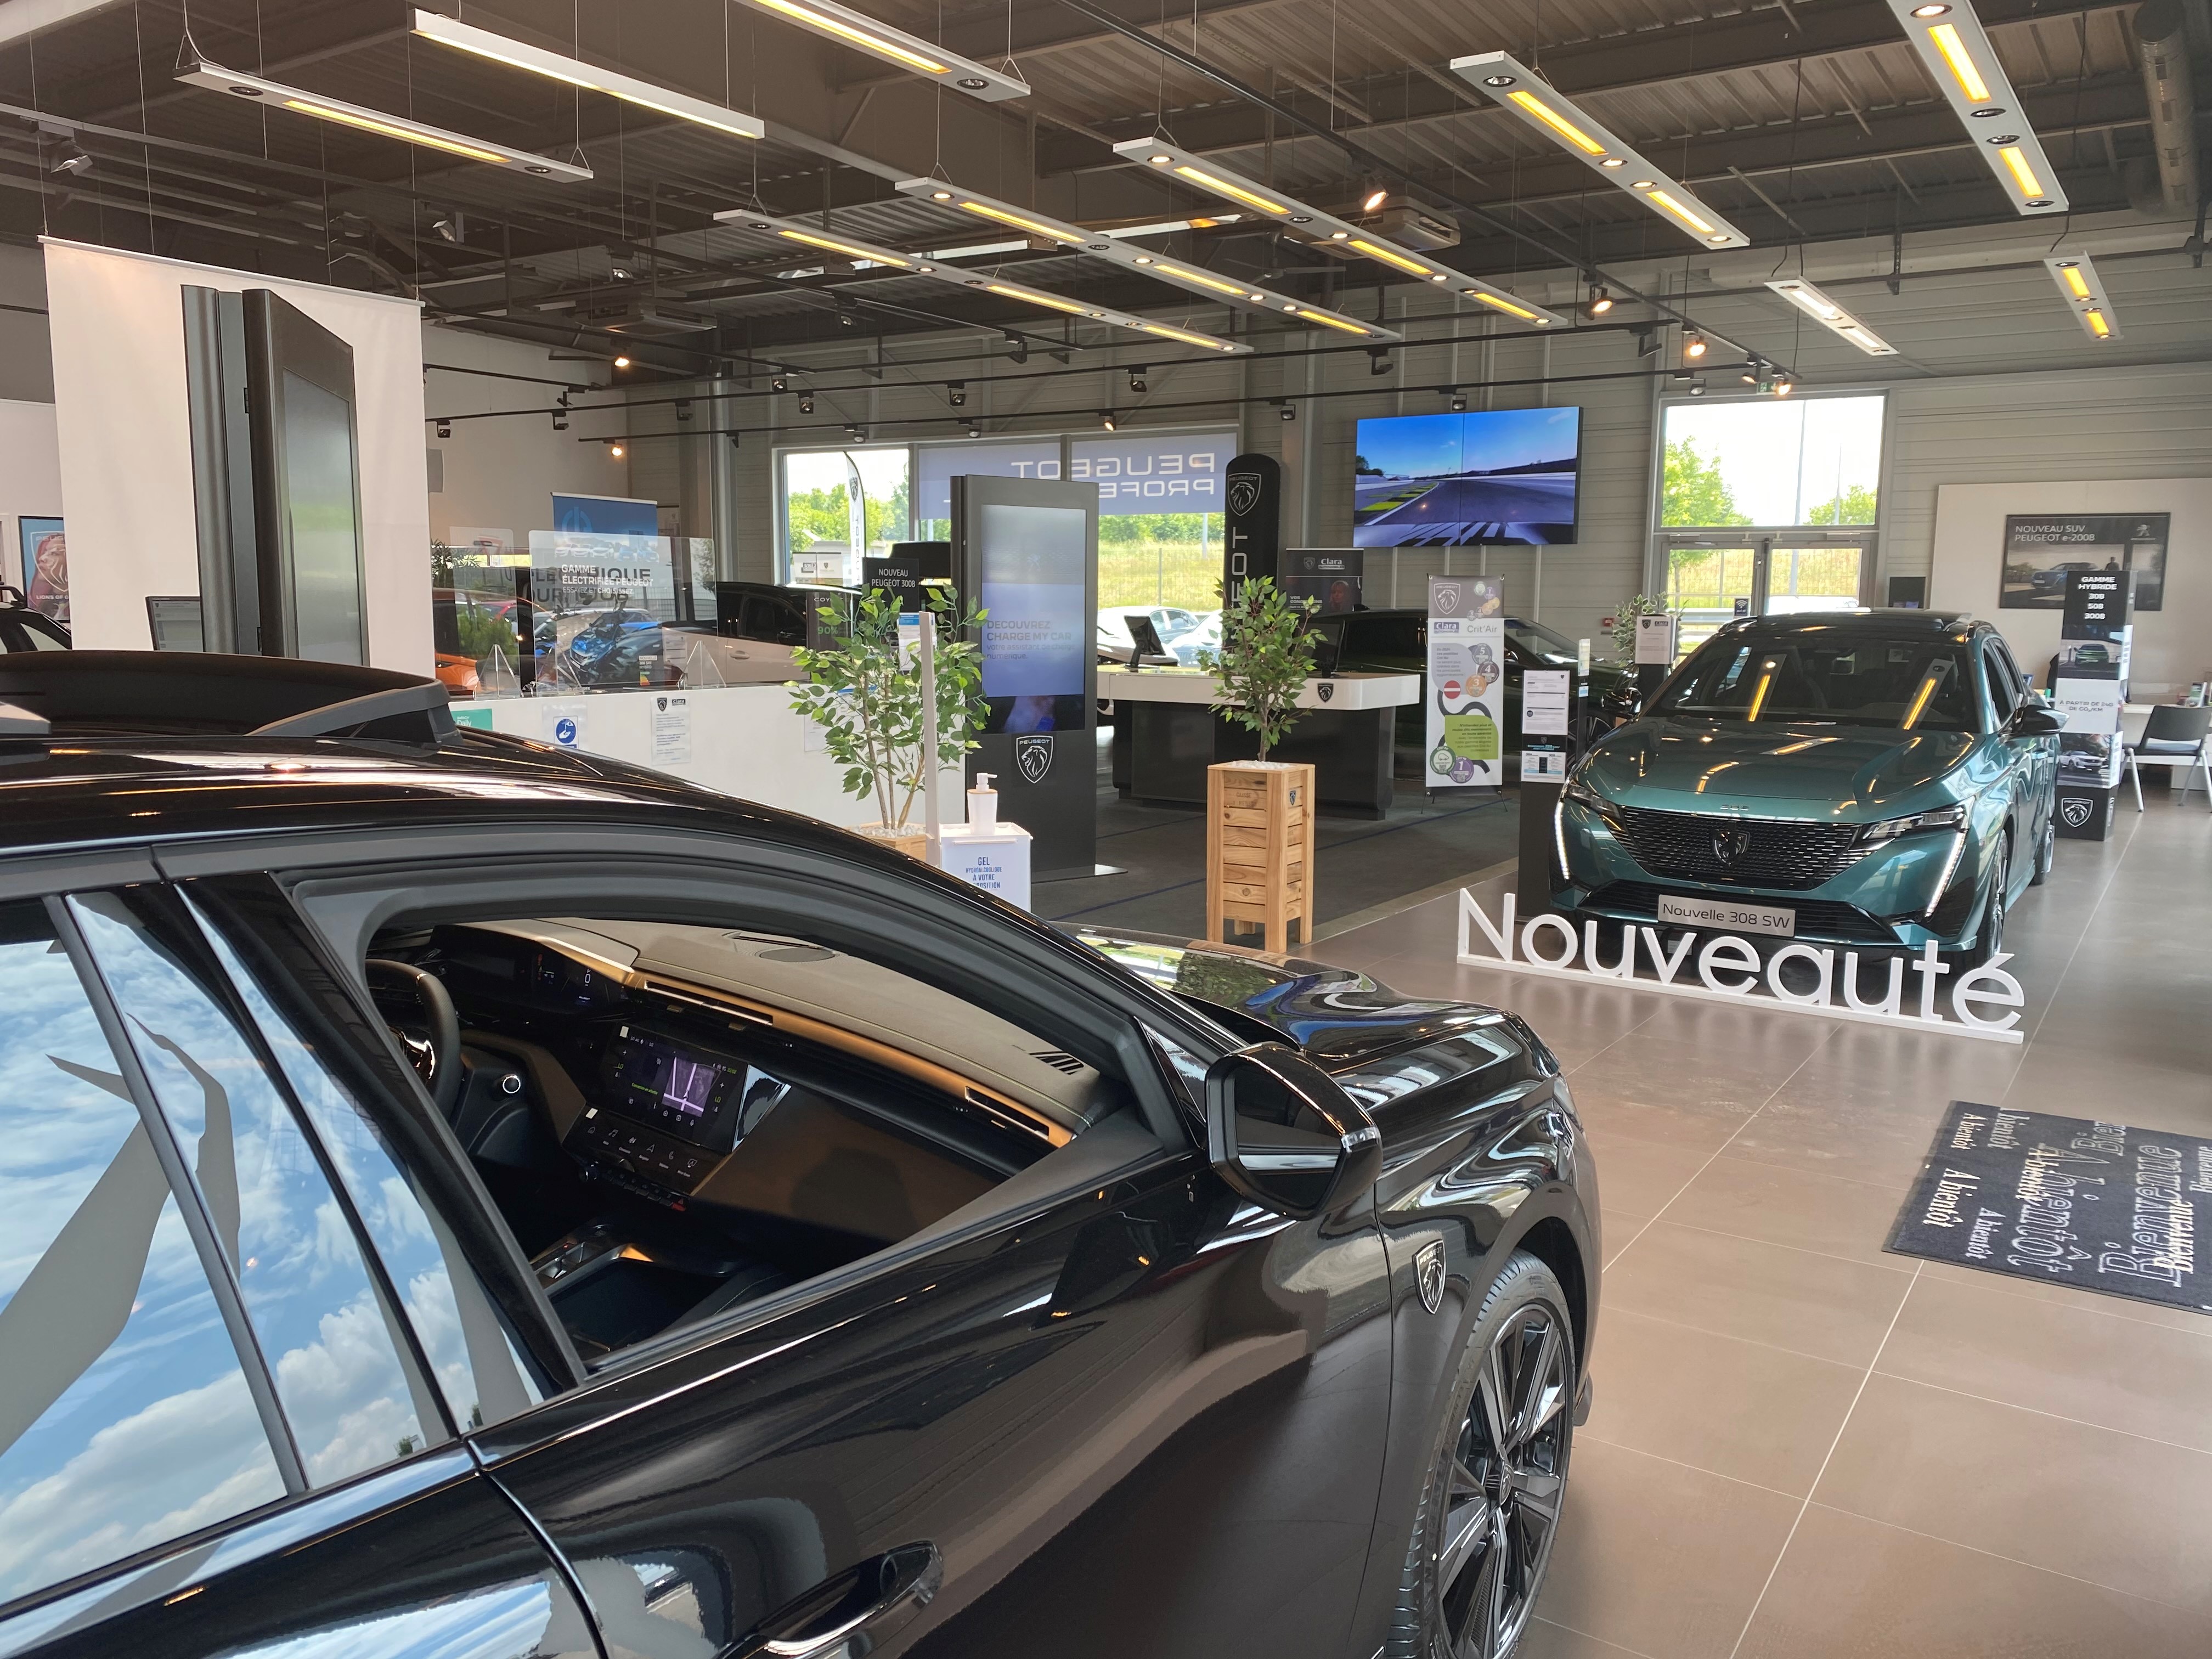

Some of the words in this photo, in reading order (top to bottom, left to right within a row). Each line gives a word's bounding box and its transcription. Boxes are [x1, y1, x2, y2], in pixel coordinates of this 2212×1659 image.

[2016, 525, 2063, 533] NOUVEAU
[2015, 534, 2060, 542] PEUGEOT
[2062, 534, 2096, 542] e-2008
[561, 564, 596, 574] GAMME
[878, 568, 909, 577] NOUVEAU
[871, 579, 900, 587] PEUGEOT
[901, 579, 915, 588] 3008
[988, 620, 1051, 630] DECOUVREZ
[987, 633, 1031, 641] CHARGE
[1032, 633, 1048, 641] MY
[1050, 633, 1071, 641] CAR
[457, 719, 472, 727] Daily
[978, 856, 990, 866] GEL
[1662, 903, 1725, 922] Nouvelle
[1729, 911, 1758, 925] 308
[1762, 915, 1790, 929] SW
[1458, 887, 2025, 1031] Nouveauté
[1951, 1120, 1984, 1150] bientôt
[1922, 1178, 1978, 1228] bientôt
[1965, 1217, 1997, 1260] bientôt
[2153, 1198, 2194, 1274] Bienvenue
[1419, 1246, 1442, 1265] PEUGEOT
